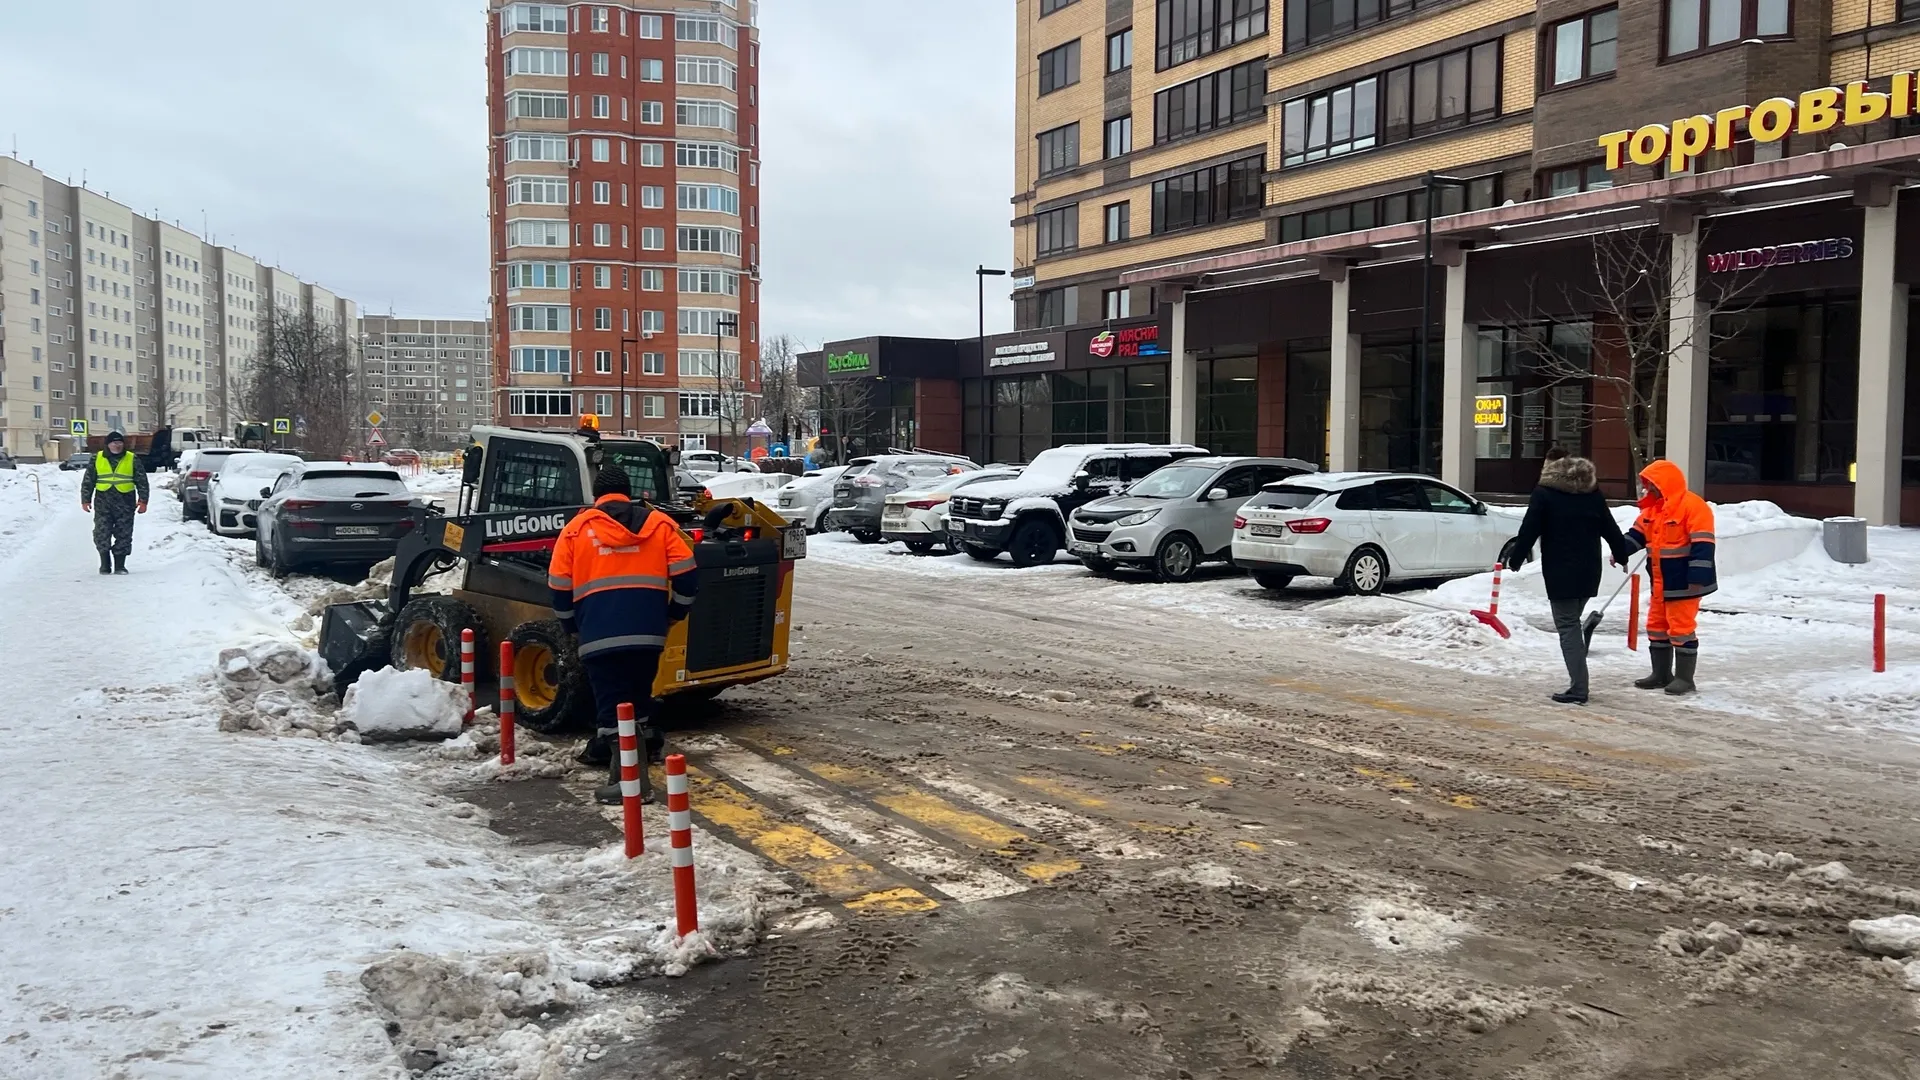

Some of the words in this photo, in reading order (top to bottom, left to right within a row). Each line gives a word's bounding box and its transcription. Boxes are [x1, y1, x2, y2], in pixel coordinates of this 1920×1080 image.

[1598, 71, 1920, 173] торговы
[1707, 237, 1853, 273] WILDBERRIES
[1118, 343, 1138, 356] РЯД
[1476, 400, 1502, 410] ОКНА
[1475, 413, 1504, 424] REHAU
